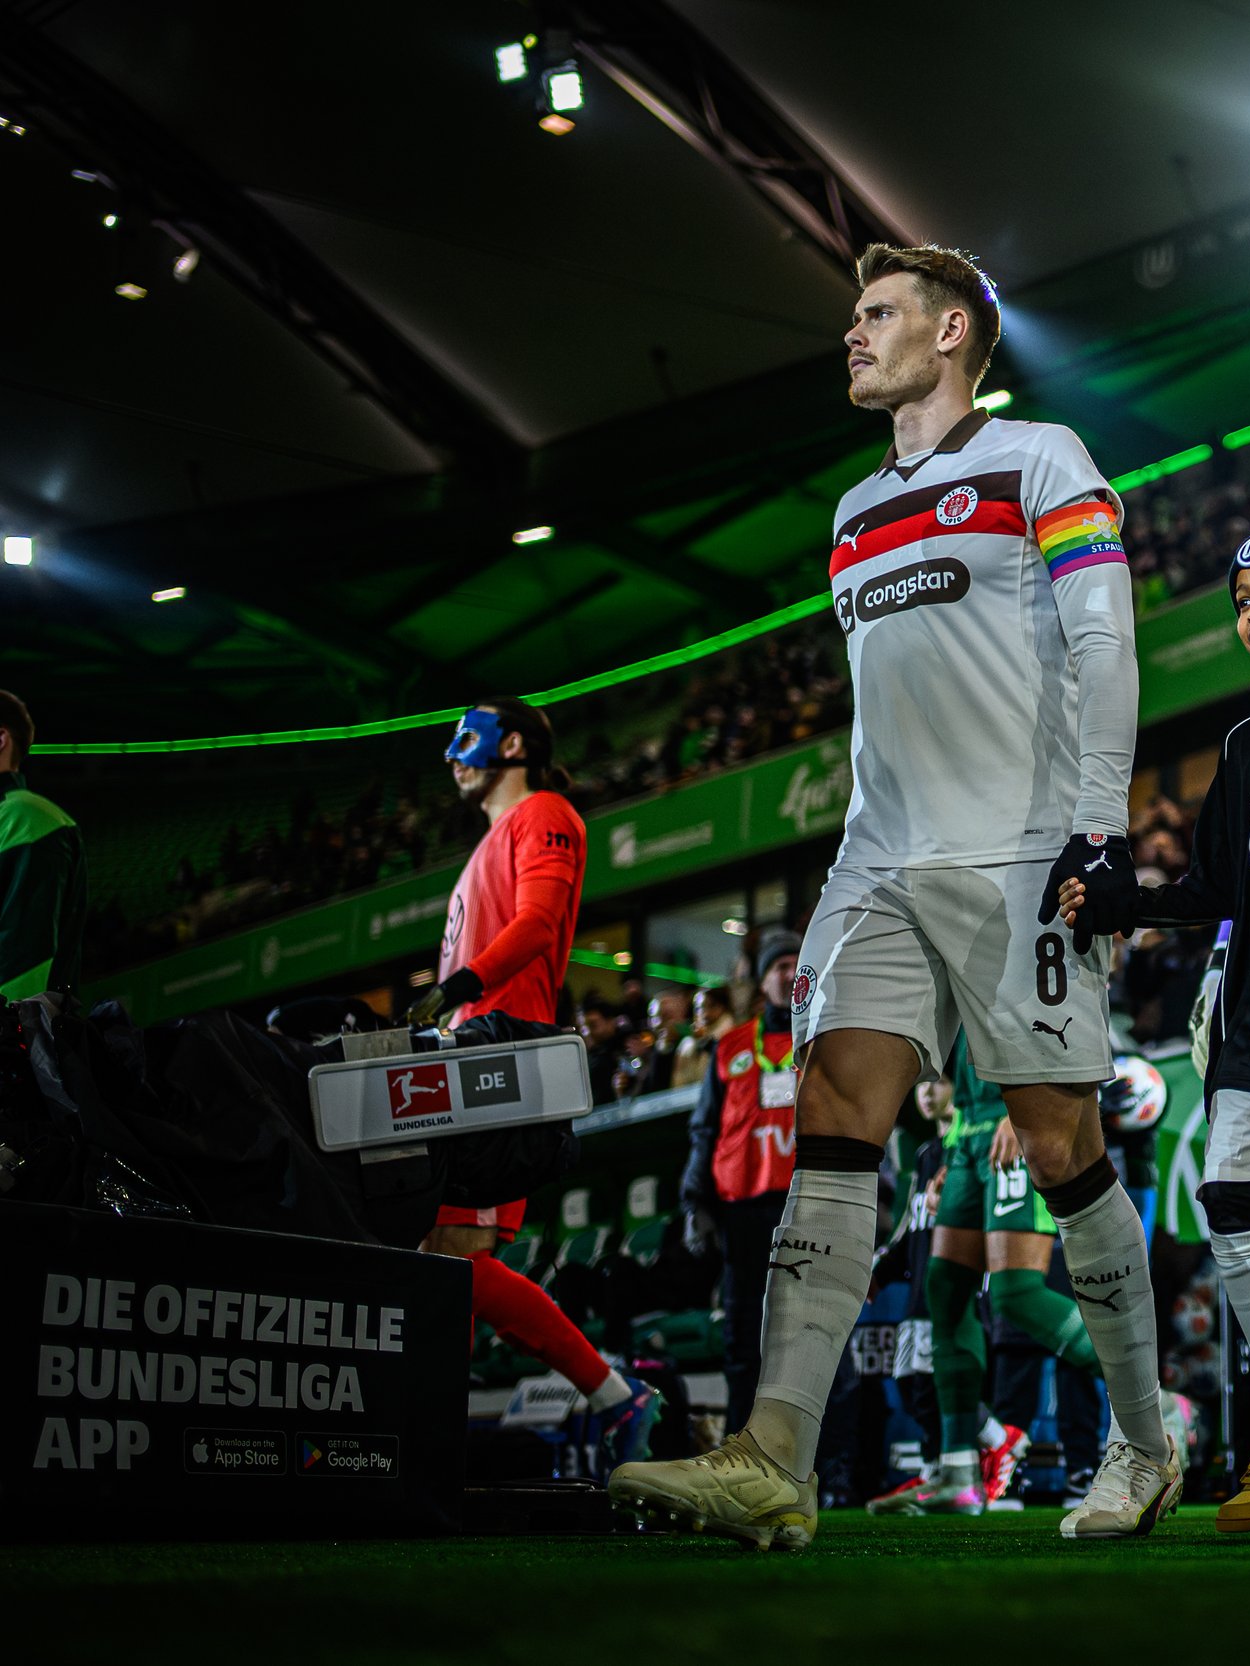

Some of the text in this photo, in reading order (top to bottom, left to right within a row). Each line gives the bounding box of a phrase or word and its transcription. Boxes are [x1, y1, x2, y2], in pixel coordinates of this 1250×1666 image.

[960, 487, 977, 502] PAULI
[944, 516, 962, 524] 1910
[864, 570, 956, 608] congstar
[1035, 932, 1068, 1006] 8
[474, 1071, 506, 1092] .DE
[393, 1115, 454, 1132] BUNDESLIGA
[752, 1124, 795, 1160] TV
[42, 1273, 405, 1353] DIE OFFIZIELLE
[37, 1344, 366, 1413] BUNDESLIGA
[32, 1417, 151, 1470] APP
[214, 1438, 275, 1449] Download on the
[327, 1440, 360, 1449] GET IT ON
[214, 1448, 279, 1468] App Store
[327, 1452, 393, 1473] Google Play
